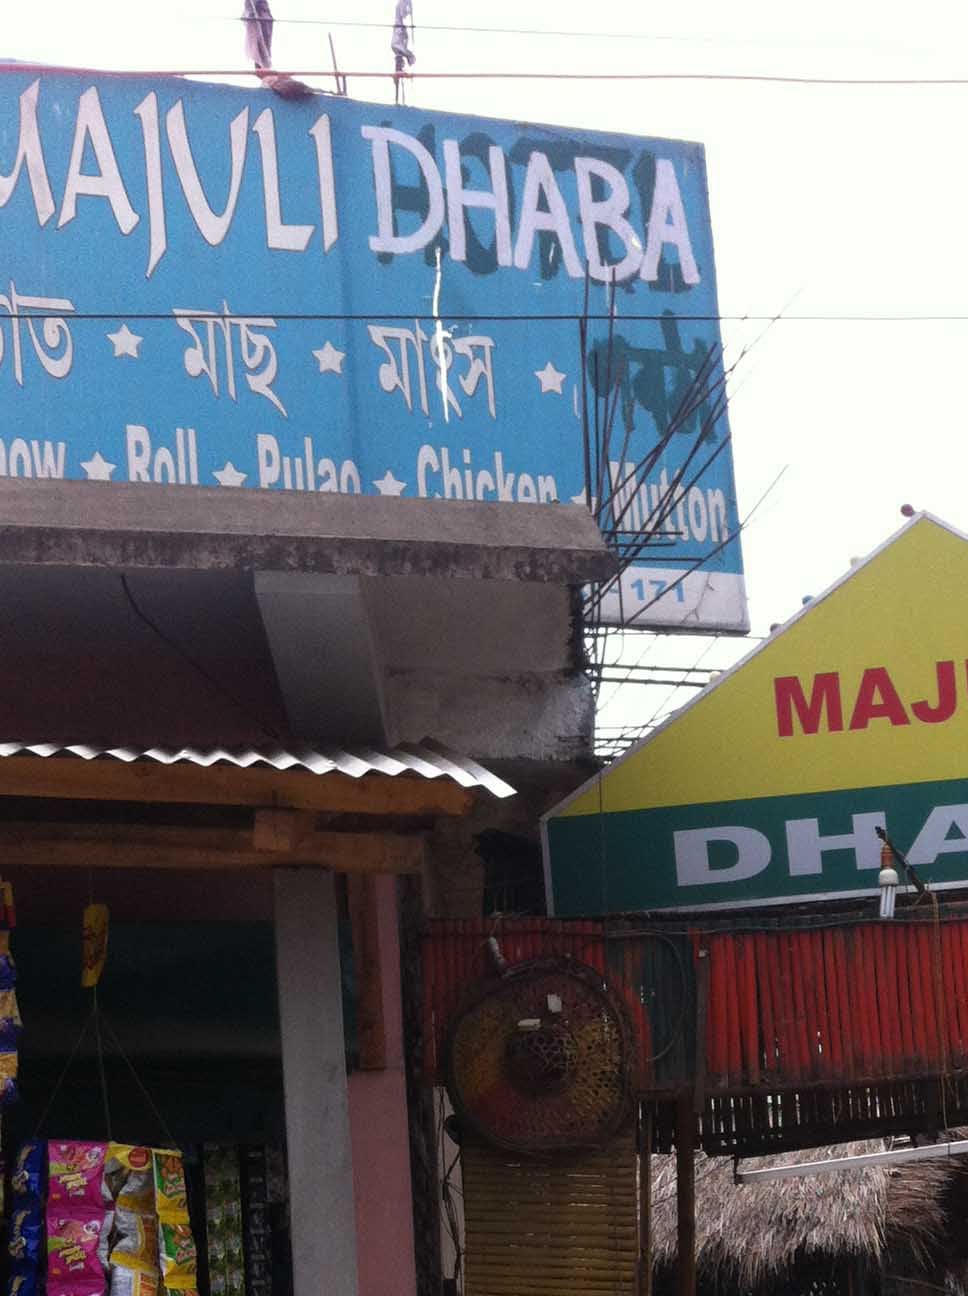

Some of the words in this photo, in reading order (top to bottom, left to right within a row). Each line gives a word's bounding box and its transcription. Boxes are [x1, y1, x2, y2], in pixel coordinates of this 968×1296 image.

[361, 125, 700, 285] DHABA
[172, 299, 289, 418] মাছ
[126, 424, 199, 485] Roll
[416, 444, 558, 503] Chicken
[609, 461, 728, 543] Mutton
[631, 577, 686, 602] 171
